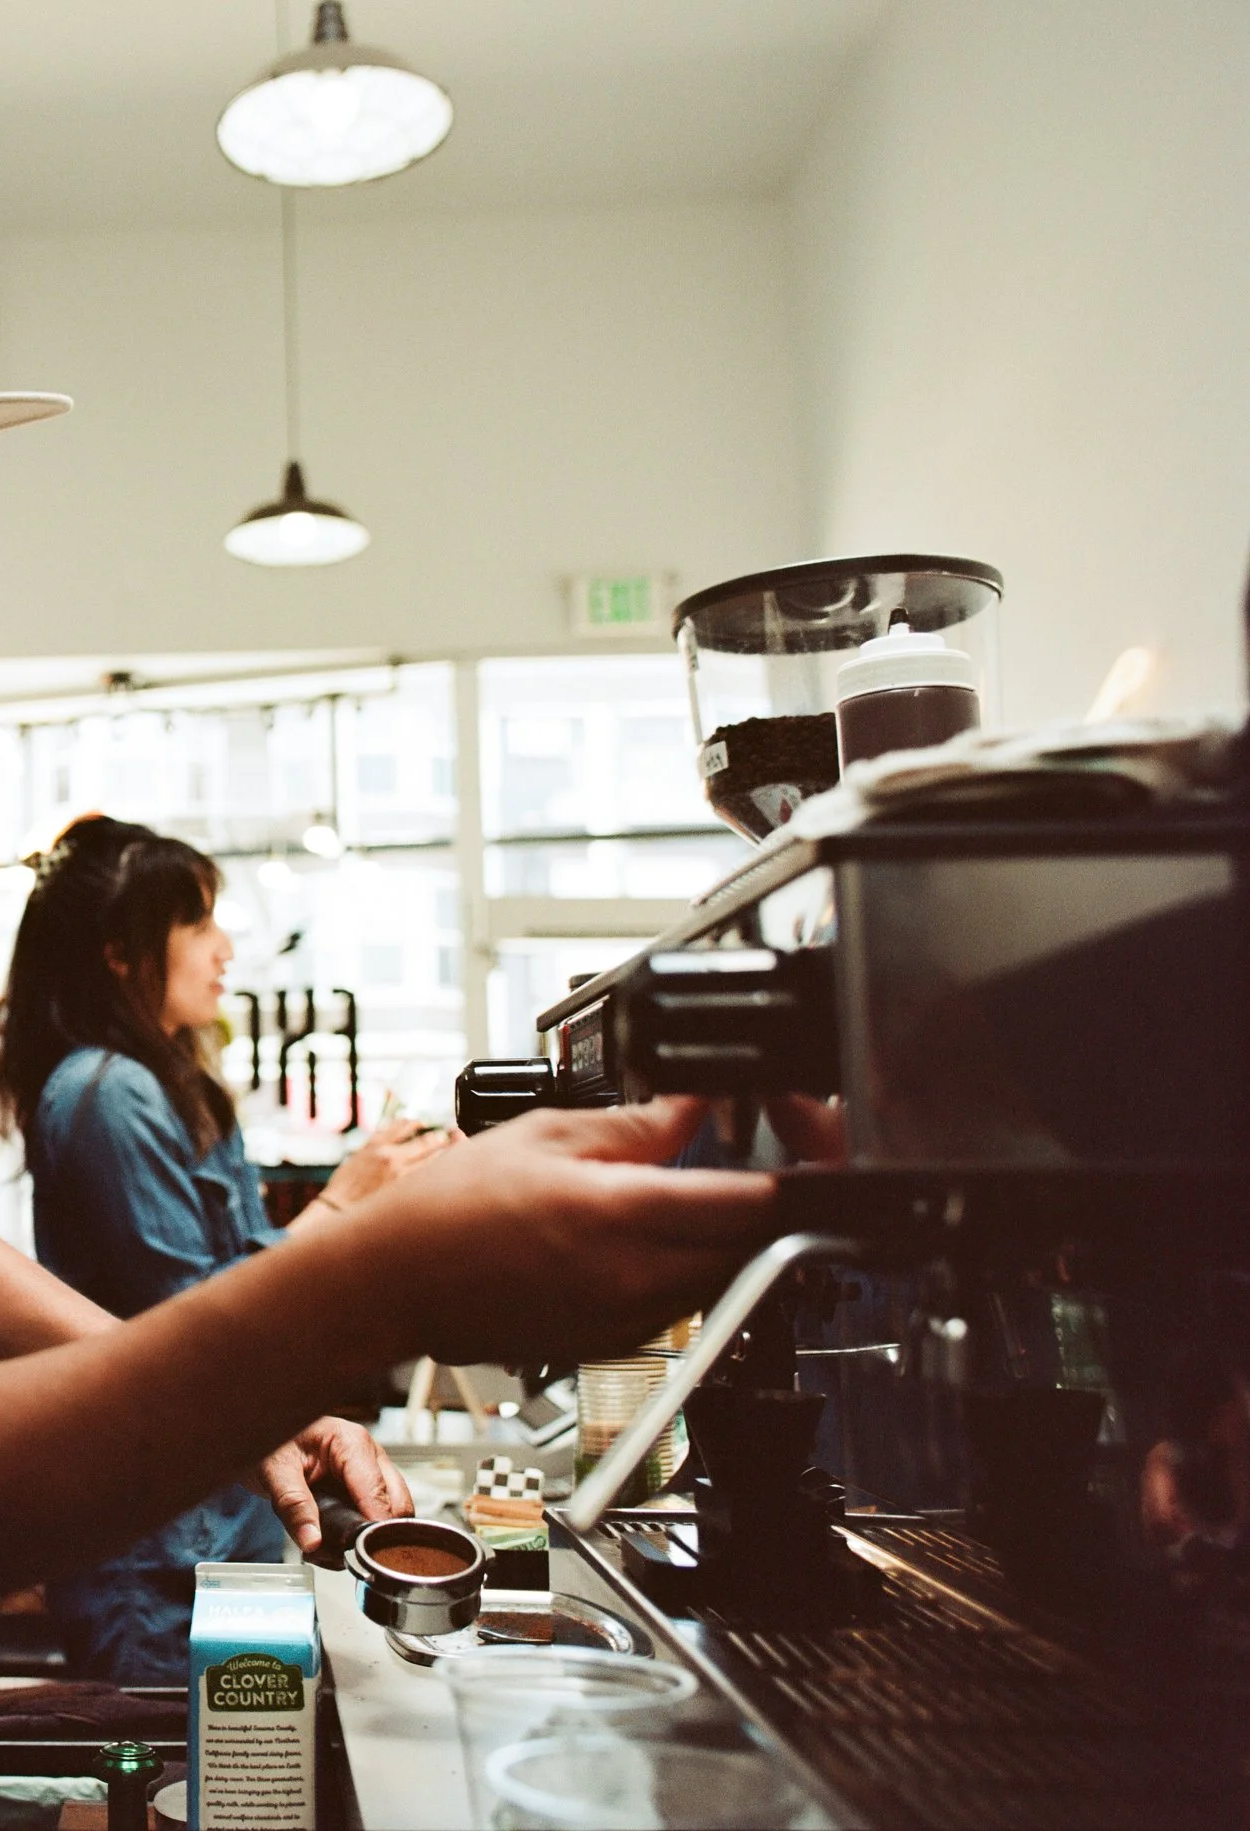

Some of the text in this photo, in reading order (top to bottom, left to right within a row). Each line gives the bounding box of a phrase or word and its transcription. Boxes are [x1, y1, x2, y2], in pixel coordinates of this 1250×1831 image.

[227, 1658, 282, 1671] Welcome to
[220, 1673, 289, 1689] CLOVER
[213, 1690, 298, 1706] COUNTRY
